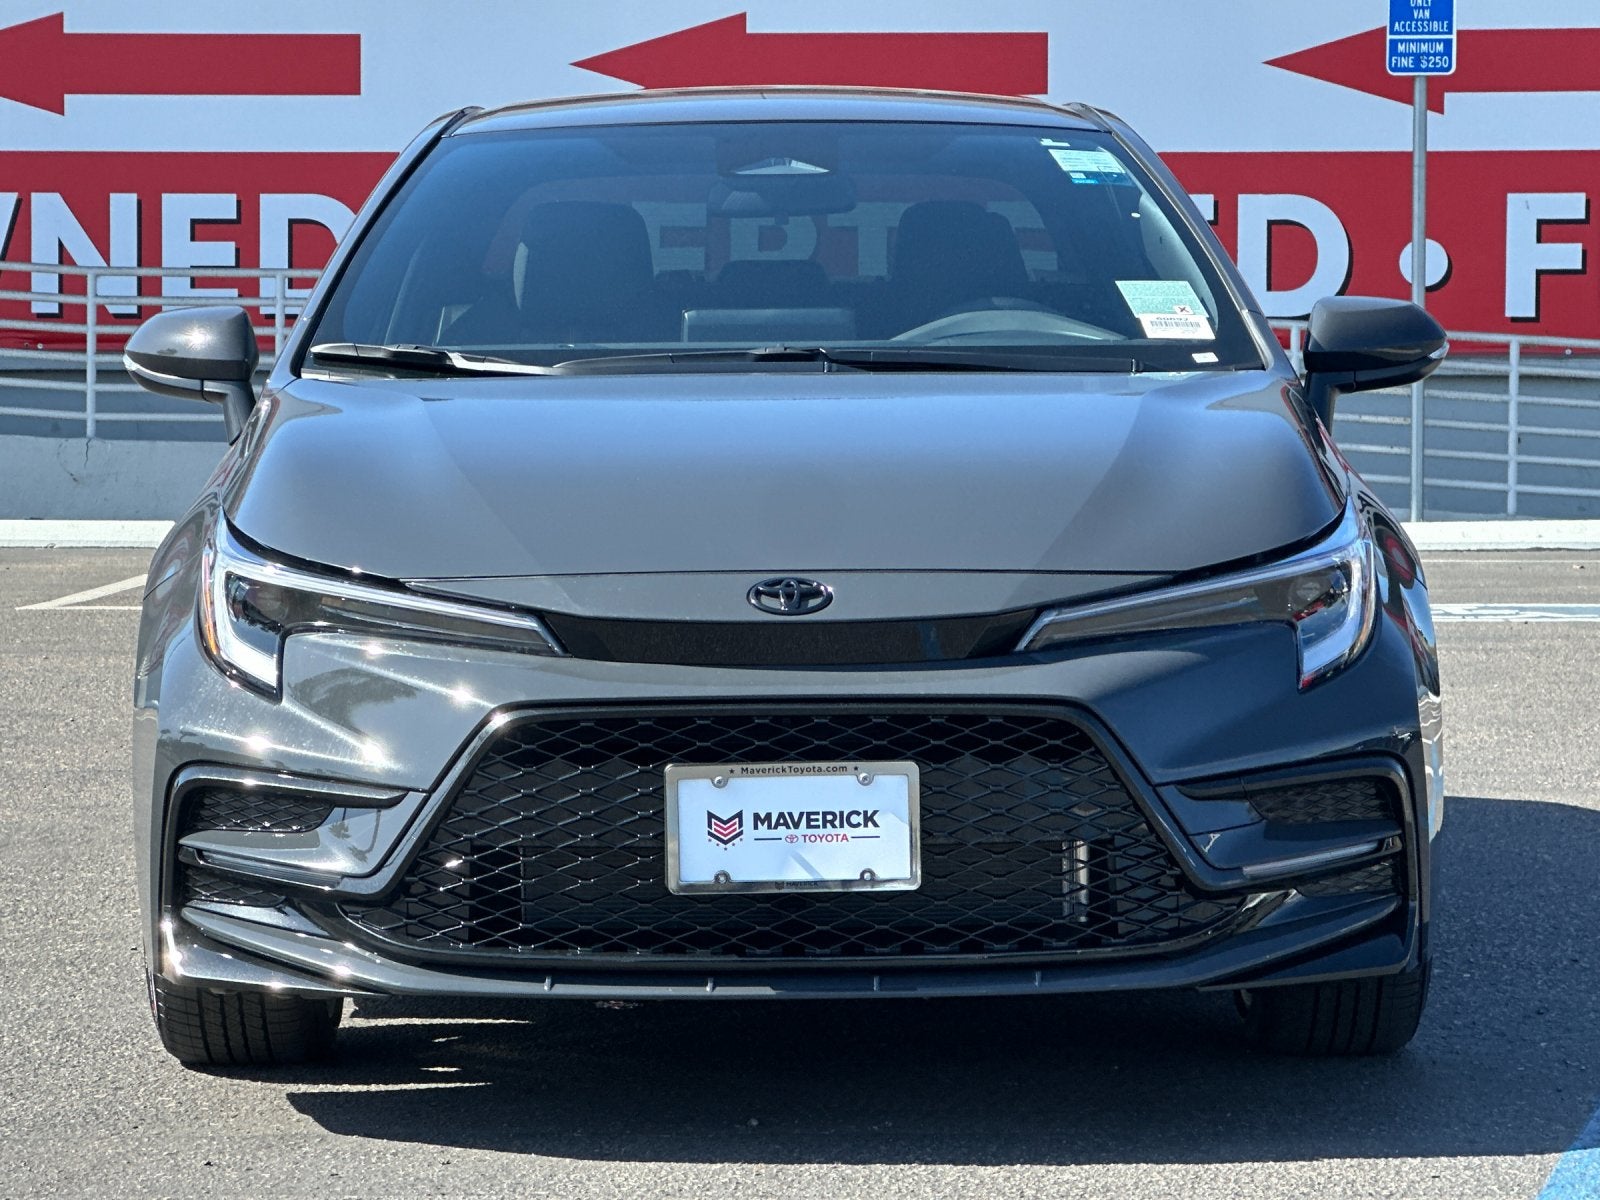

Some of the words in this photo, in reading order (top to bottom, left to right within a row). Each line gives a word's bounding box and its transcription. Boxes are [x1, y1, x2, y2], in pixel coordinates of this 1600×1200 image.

[1413, 9, 1430, 19] VAN
[1393, 21, 1449, 32] ACCESSIBLE
[1397, 42, 1444, 54] MINIMUM
[1391, 56, 1415, 68] FINE
[1420, 55, 1449, 69] $250
[0, 192, 356, 316] NED
[740, 765, 848, 776] MaverickToyota.com
[753, 810, 880, 831] MAVERICK
[801, 834, 849, 843] TOYOTA
